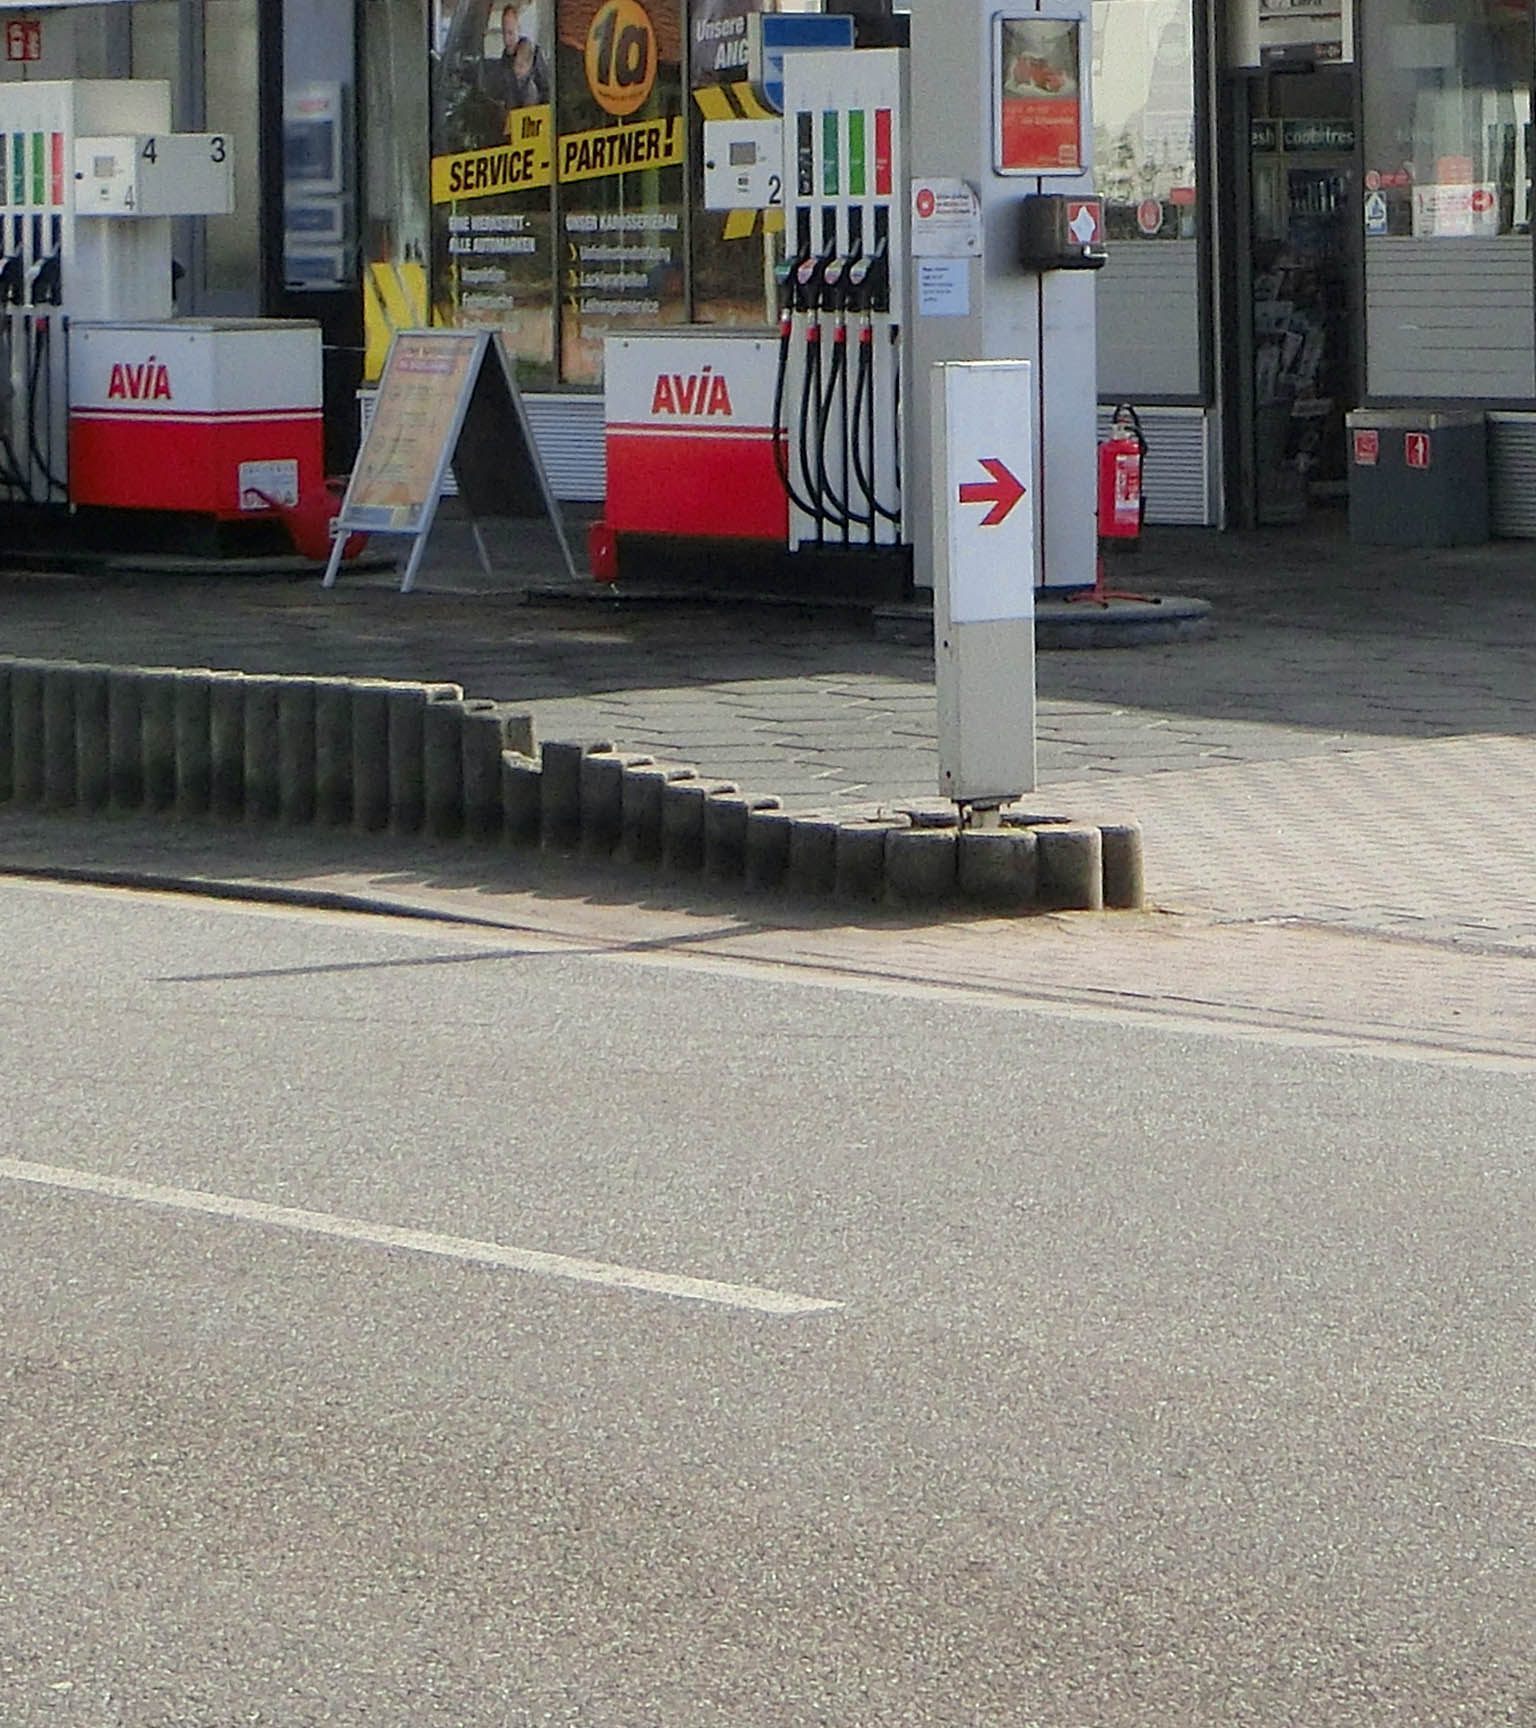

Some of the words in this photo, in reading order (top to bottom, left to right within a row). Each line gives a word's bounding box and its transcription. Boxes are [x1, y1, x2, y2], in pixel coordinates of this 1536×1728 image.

[696, 16, 745, 42] Unsere
[594, 8, 648, 87] 1a
[713, 38, 749, 70] ANG
[521, 115, 543, 139] Ihr
[142, 138, 157, 164] 4
[210, 137, 226, 163] 3
[450, 148, 534, 193] SERVICE
[565, 116, 674, 174] PARTNER!
[124, 186, 135, 211] 4
[768, 174, 782, 204] 2
